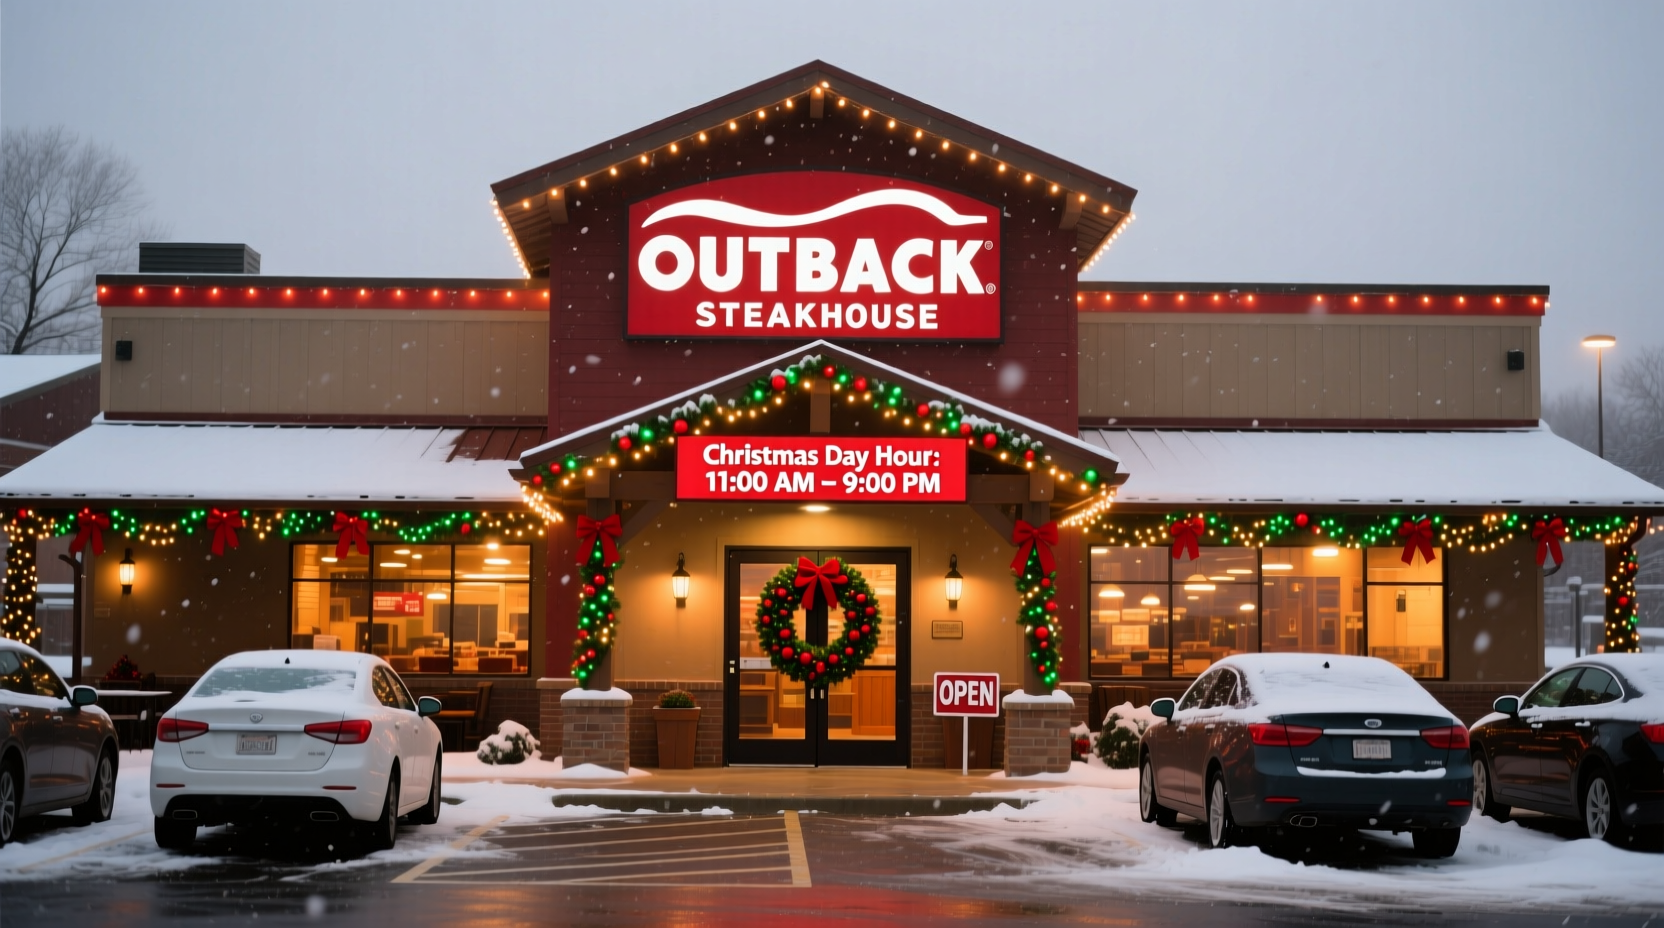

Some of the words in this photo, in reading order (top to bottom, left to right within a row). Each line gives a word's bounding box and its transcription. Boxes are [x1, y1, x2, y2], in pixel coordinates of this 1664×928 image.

[637, 234, 985, 294] OUTBACK
[695, 301, 938, 330] STEAKHOUSE
[702, 442, 819, 467] Christmas
[825, 444, 870, 473] Day
[875, 445, 940, 467] Hour:
[705, 471, 768, 493] 11:00
[773, 471, 815, 493] AM
[842, 472, 896, 494] 9:00
[902, 472, 941, 494] PM
[939, 679, 994, 707] OPEN
